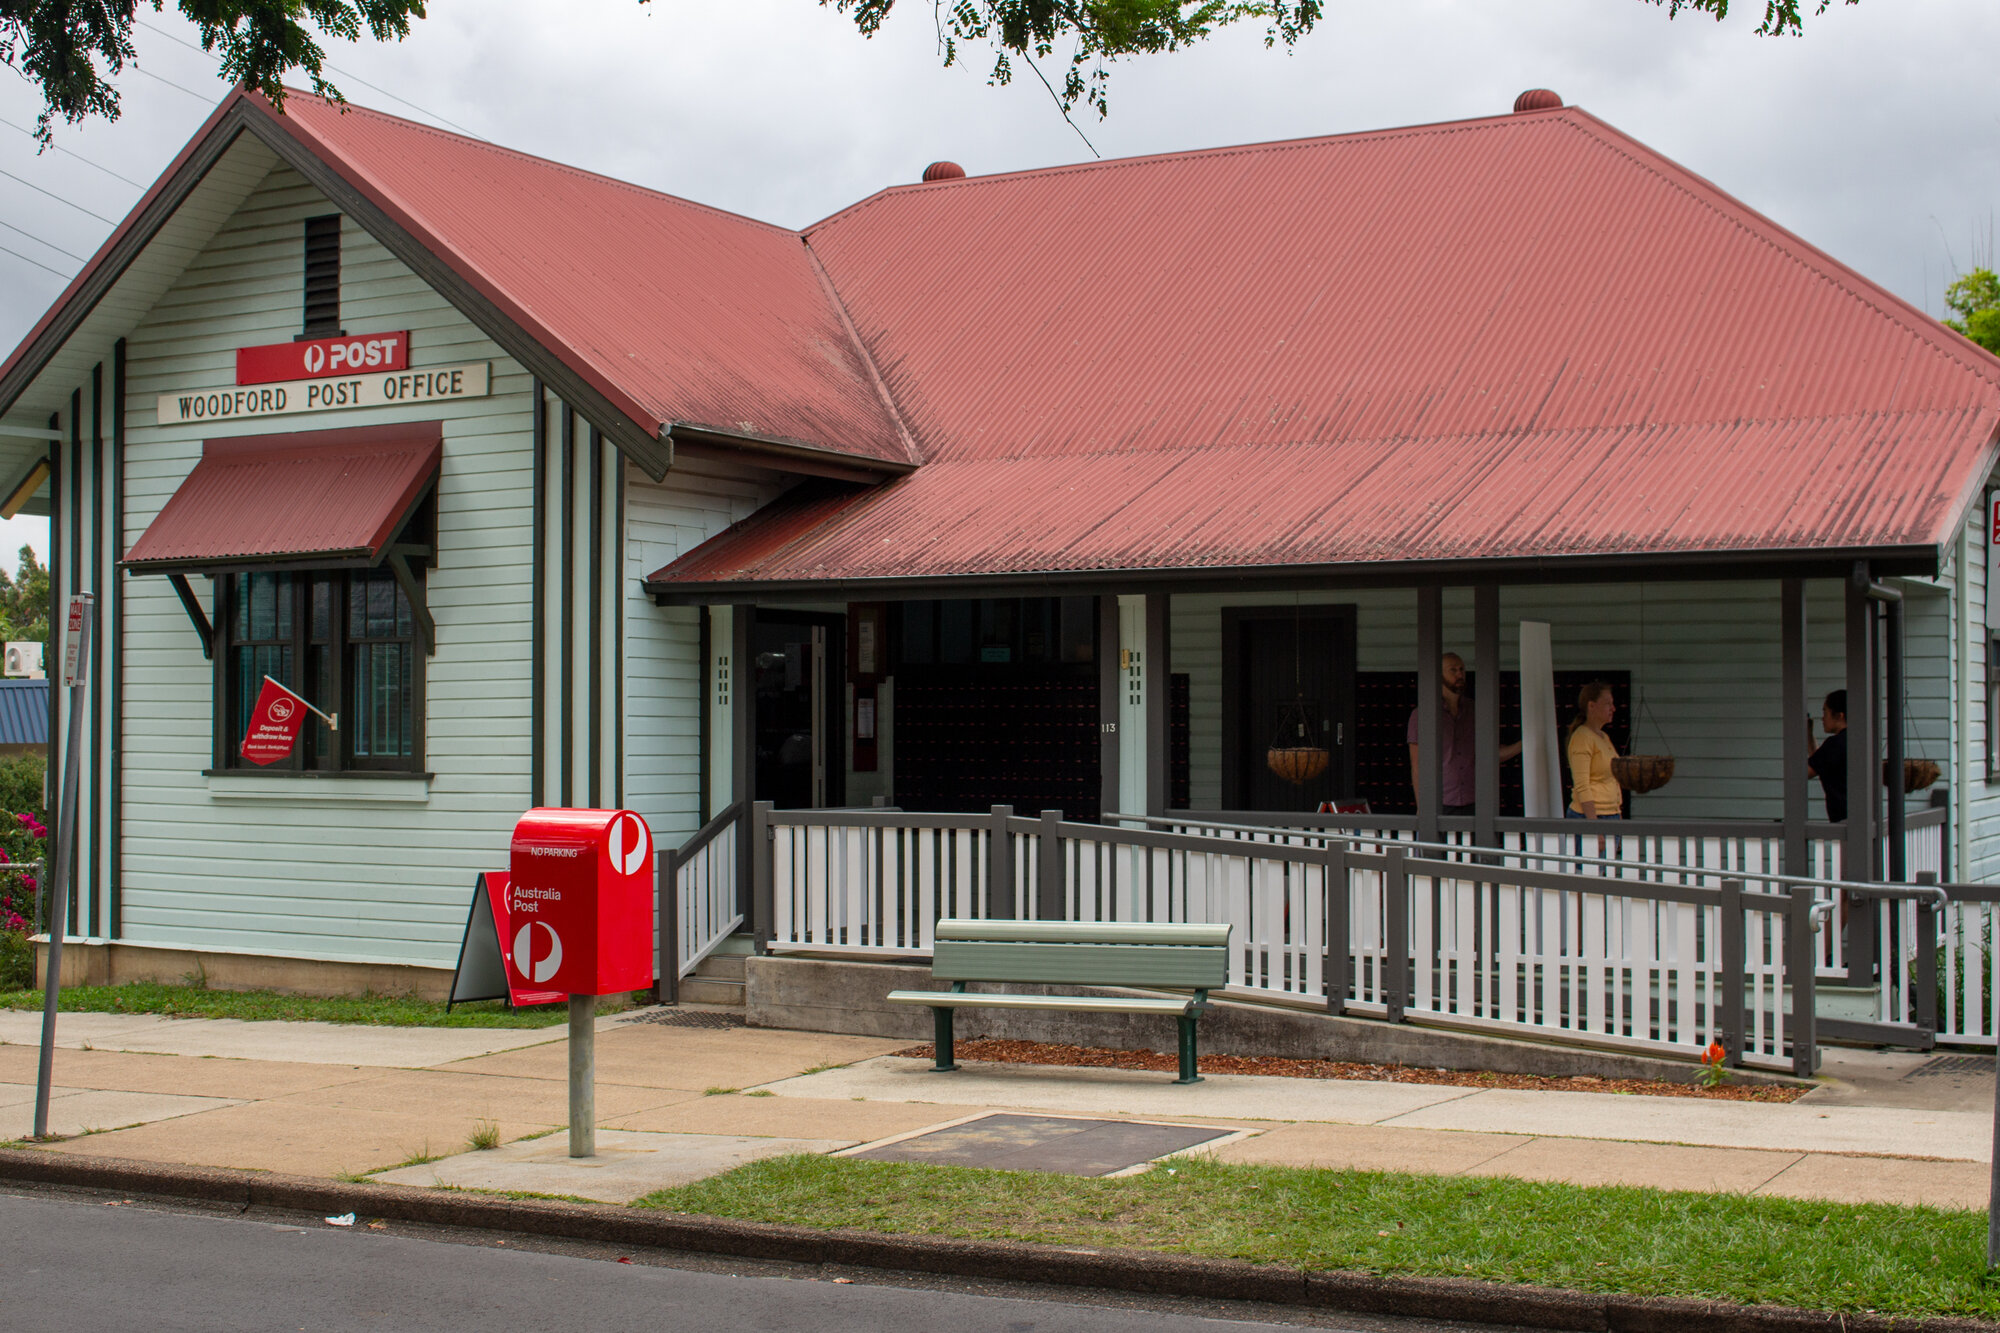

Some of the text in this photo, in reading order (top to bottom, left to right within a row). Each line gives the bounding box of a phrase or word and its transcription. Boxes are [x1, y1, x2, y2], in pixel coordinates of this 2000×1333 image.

[330, 338, 398, 370] POST
[178, 370, 464, 419] WOODFORD POST OFFICE
[70, 604, 82, 616] MAIL
[260, 724, 283, 732] Deposit
[1101, 723, 1116, 733] 113
[531, 847, 578, 858] NO PARKING
[513, 886, 561, 901] Australia
[513, 899, 539, 913] Post
